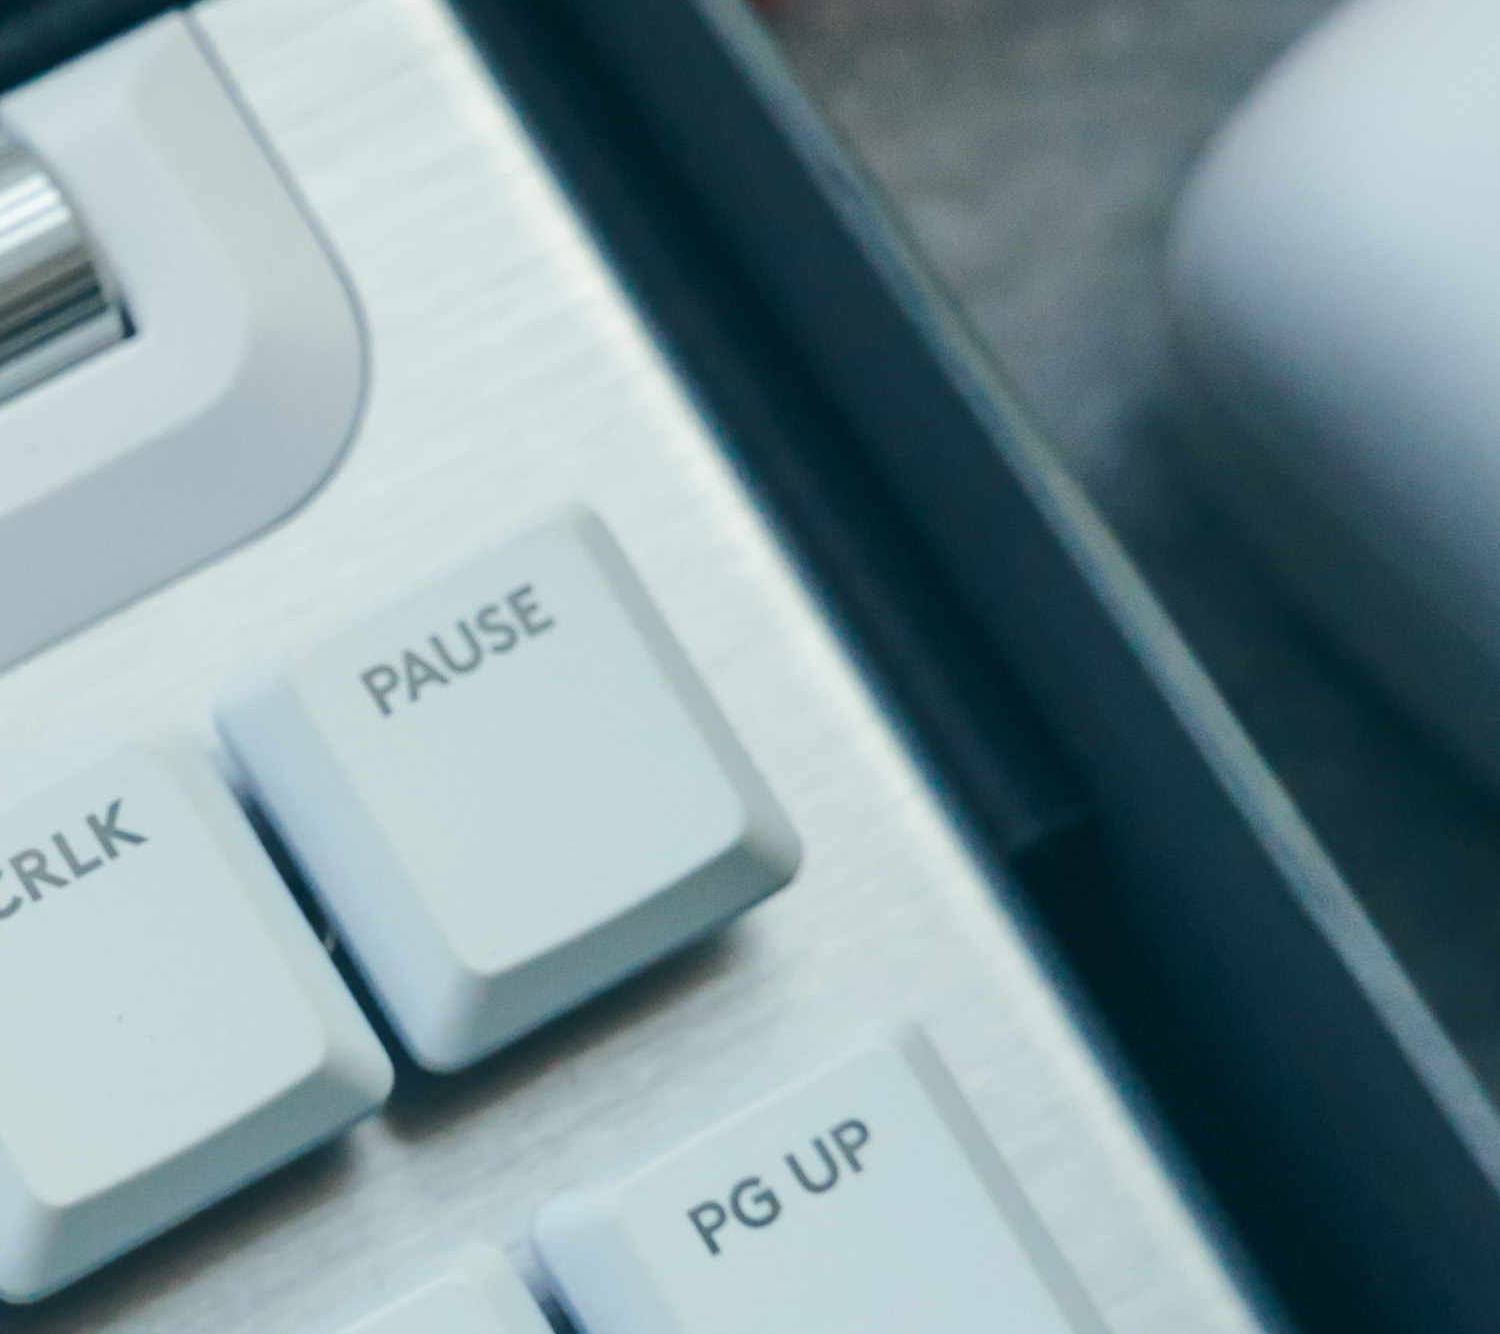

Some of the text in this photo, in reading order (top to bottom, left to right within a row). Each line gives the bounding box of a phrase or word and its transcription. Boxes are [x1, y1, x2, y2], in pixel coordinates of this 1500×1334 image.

[359, 583, 556, 718] PAUSE
[686, 1118, 871, 1257] PG UP
